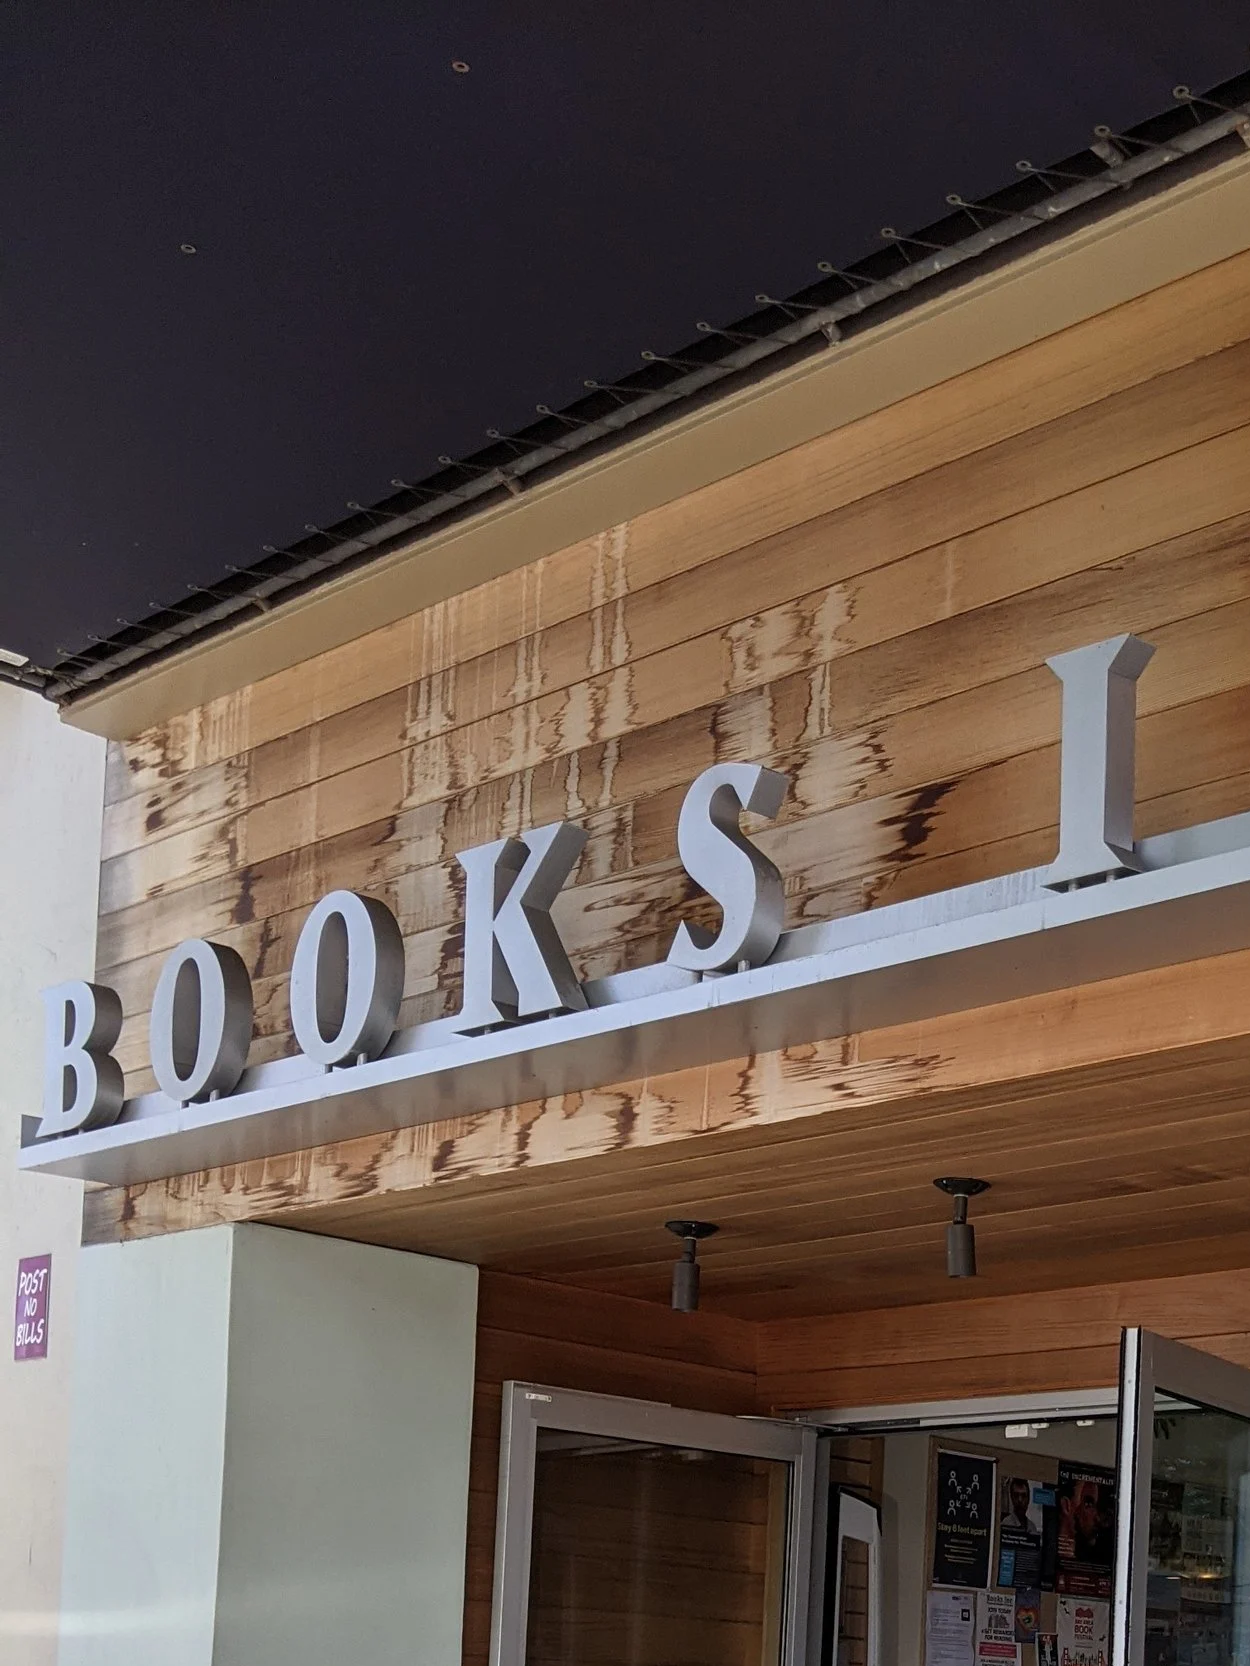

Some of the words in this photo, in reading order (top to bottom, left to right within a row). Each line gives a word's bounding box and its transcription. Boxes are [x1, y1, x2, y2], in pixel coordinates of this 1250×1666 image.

[34, 762, 788, 1138] BOOKS
[18, 1269, 48, 1297] POST
[24, 1297, 37, 1317] NO
[16, 1318, 44, 1347] BILLS
[1074, 1625, 1094, 1634] BOOK
